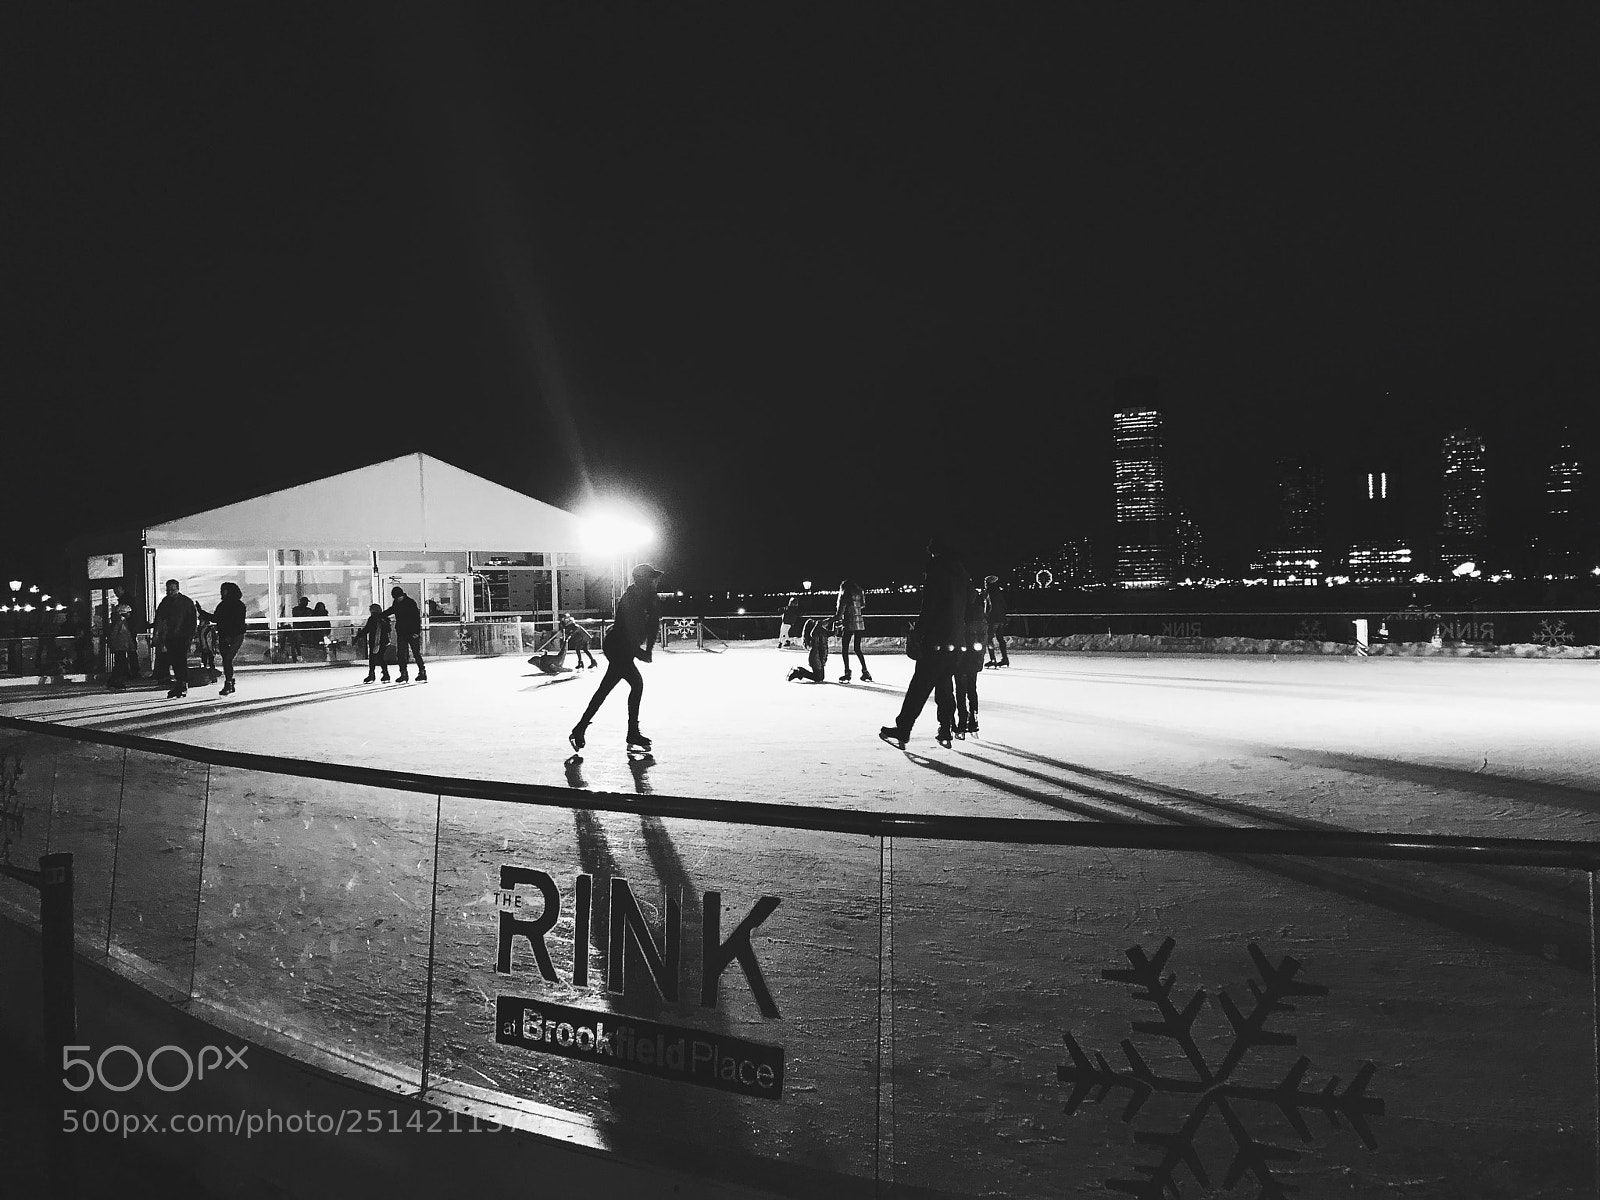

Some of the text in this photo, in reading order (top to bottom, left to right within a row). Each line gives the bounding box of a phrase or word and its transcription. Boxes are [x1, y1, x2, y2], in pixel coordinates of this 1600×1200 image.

[493, 892, 522, 909] THE
[497, 864, 782, 1020] RINK
[502, 1007, 775, 1089] at Brookfield Place
